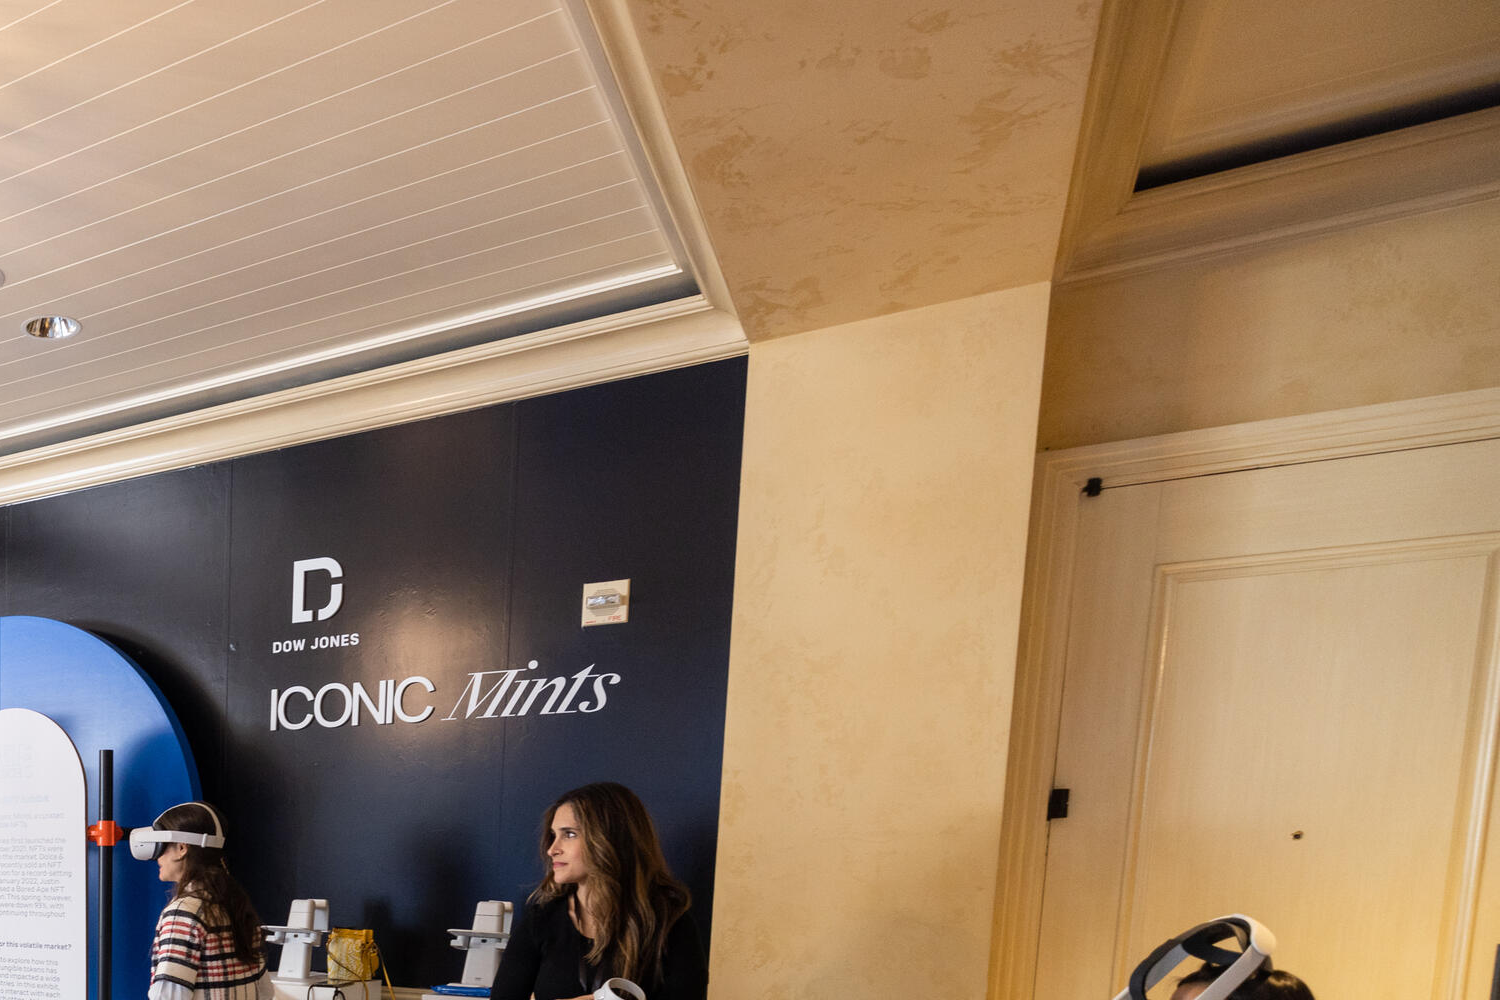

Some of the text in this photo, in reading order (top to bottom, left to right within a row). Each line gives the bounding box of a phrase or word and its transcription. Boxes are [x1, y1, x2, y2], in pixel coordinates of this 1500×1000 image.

[272, 632, 360, 654] DOW JONES
[270, 660, 621, 732] ICONIC Mints
[45, 942, 71, 950] market?
[8, 957, 31, 966] explore
[10, 972, 39, 982] impacted
[7, 988, 30, 996] interact
